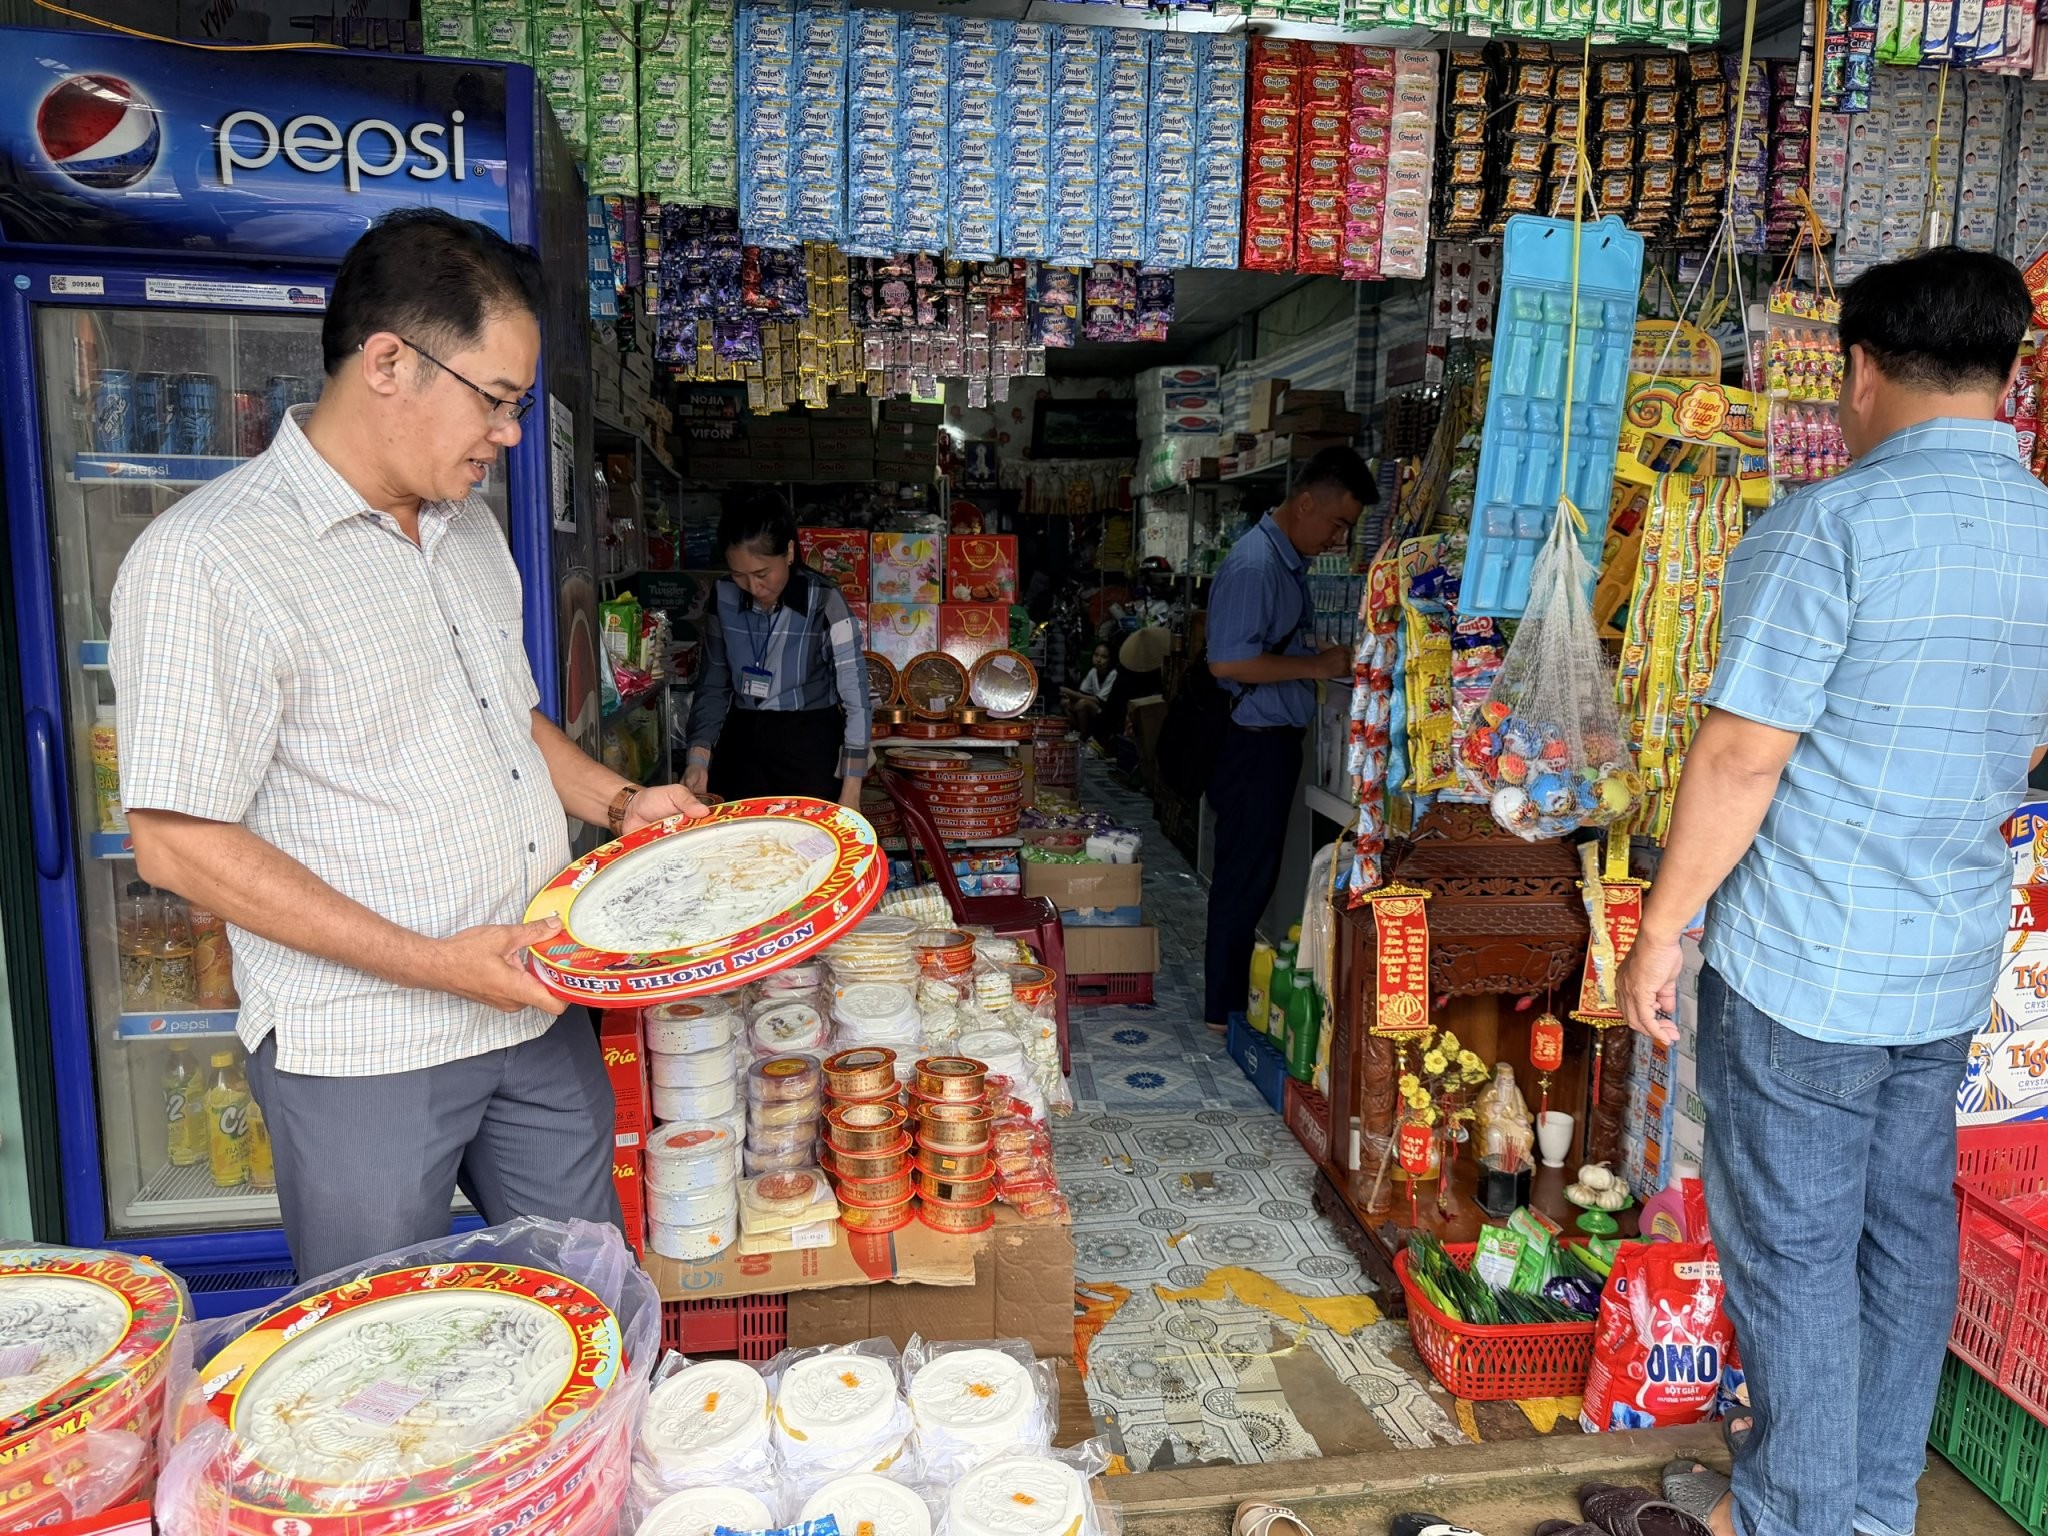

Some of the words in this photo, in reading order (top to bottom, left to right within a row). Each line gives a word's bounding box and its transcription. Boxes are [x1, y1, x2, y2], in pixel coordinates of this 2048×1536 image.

[1930, 4, 1950, 12] Dove
[435, 21, 461, 34] Comfort
[960, 19, 988, 31] Comfort
[548, 30, 573, 44] Comfort
[754, 26, 782, 39] Comfort
[806, 27, 834, 40] Comfort
[860, 26, 888, 39] Comfort
[1113, 32, 1138, 44] Comfort
[598, 33, 622, 46] Comfort
[1850, 40, 1872, 49] CLEAR
[911, 46, 939, 58] Comfort
[1210, 42, 1236, 53] Comfort
[1828, 44, 1848, 54] CLEA
[1404, 53, 1429, 64] Comfort
[1062, 66, 1089, 77] Comfort
[707, 78, 728, 91] Comfort
[1161, 75, 1187, 87] Comfort
[1263, 76, 1290, 88] Comfort
[1361, 87, 1386, 99] Comfort
[1401, 93, 1426, 104] Comfort
[960, 100, 988, 112] Comfort
[1014, 106, 1040, 118] Comfort
[754, 109, 782, 122] Comfort
[802, 109, 830, 122] Comfort
[860, 109, 888, 122] Comfort
[1111, 112, 1137, 124] Comfort
[600, 116, 623, 130] Comfort
[656, 120, 678, 133] Comfort
[1261, 116, 1288, 128] Comfort
[1312, 118, 1338, 129] Comfort
[909, 128, 936, 141] Comfort
[1358, 127, 1383, 138] Comfort
[1399, 131, 1423, 142] Comfort
[219, 110, 465, 192] pepsi
[1061, 147, 1088, 159] Comfort
[1208, 162, 1233, 173] Comfort
[1354, 166, 1380, 177] Comfort
[1396, 170, 1421, 181] Comfort
[1014, 188, 1040, 200] Comfort
[1157, 195, 1183, 207] Comfort
[1258, 196, 1284, 208] Comfort
[1310, 197, 1336, 208] Comfort
[1350, 205, 1377, 216] Comfort
[1393, 209, 1418, 220] Comfort
[960, 223, 988, 235] Comfort
[1110, 232, 1135, 244] Comfort
[1390, 246, 1415, 258] Comfort
[1688, 398, 1720, 412] Chupa
[1683, 409, 1716, 426] Chups
[690, 428, 730, 440] VIFON
[128, 463, 169, 478] pepsi
[822, 810, 866, 844] CAKE
[811, 843, 870, 900] MOON
[2010, 906, 2036, 930] NA
[564, 975, 620, 994] BIỆT
[629, 962, 724, 989] THƠM
[734, 922, 814, 968] NGON
[2012, 961, 2048, 999] Tig
[2024, 1002, 2048, 1010] CRYST
[171, 1018, 209, 1032] pepsi
[604, 1048, 637, 1067] Pía
[1650, 1059, 1669, 1076] COOL
[1648, 1070, 1668, 1088] PACK
[2018, 1080, 2048, 1088] CRYSTA
[1644, 1113, 1663, 1132] COOL
[1643, 1124, 1662, 1144] PACK
[1642, 1168, 1660, 1187] COOL
[1680, 1266, 1693, 1274] 2,9
[83, 1261, 166, 1305] MOON
[576, 1318, 612, 1377] CAKE
[1647, 1344, 1718, 1382] OMO
[1665, 1385, 1681, 1396] BỘT
[1682, 1386, 1700, 1396] GIẶT
